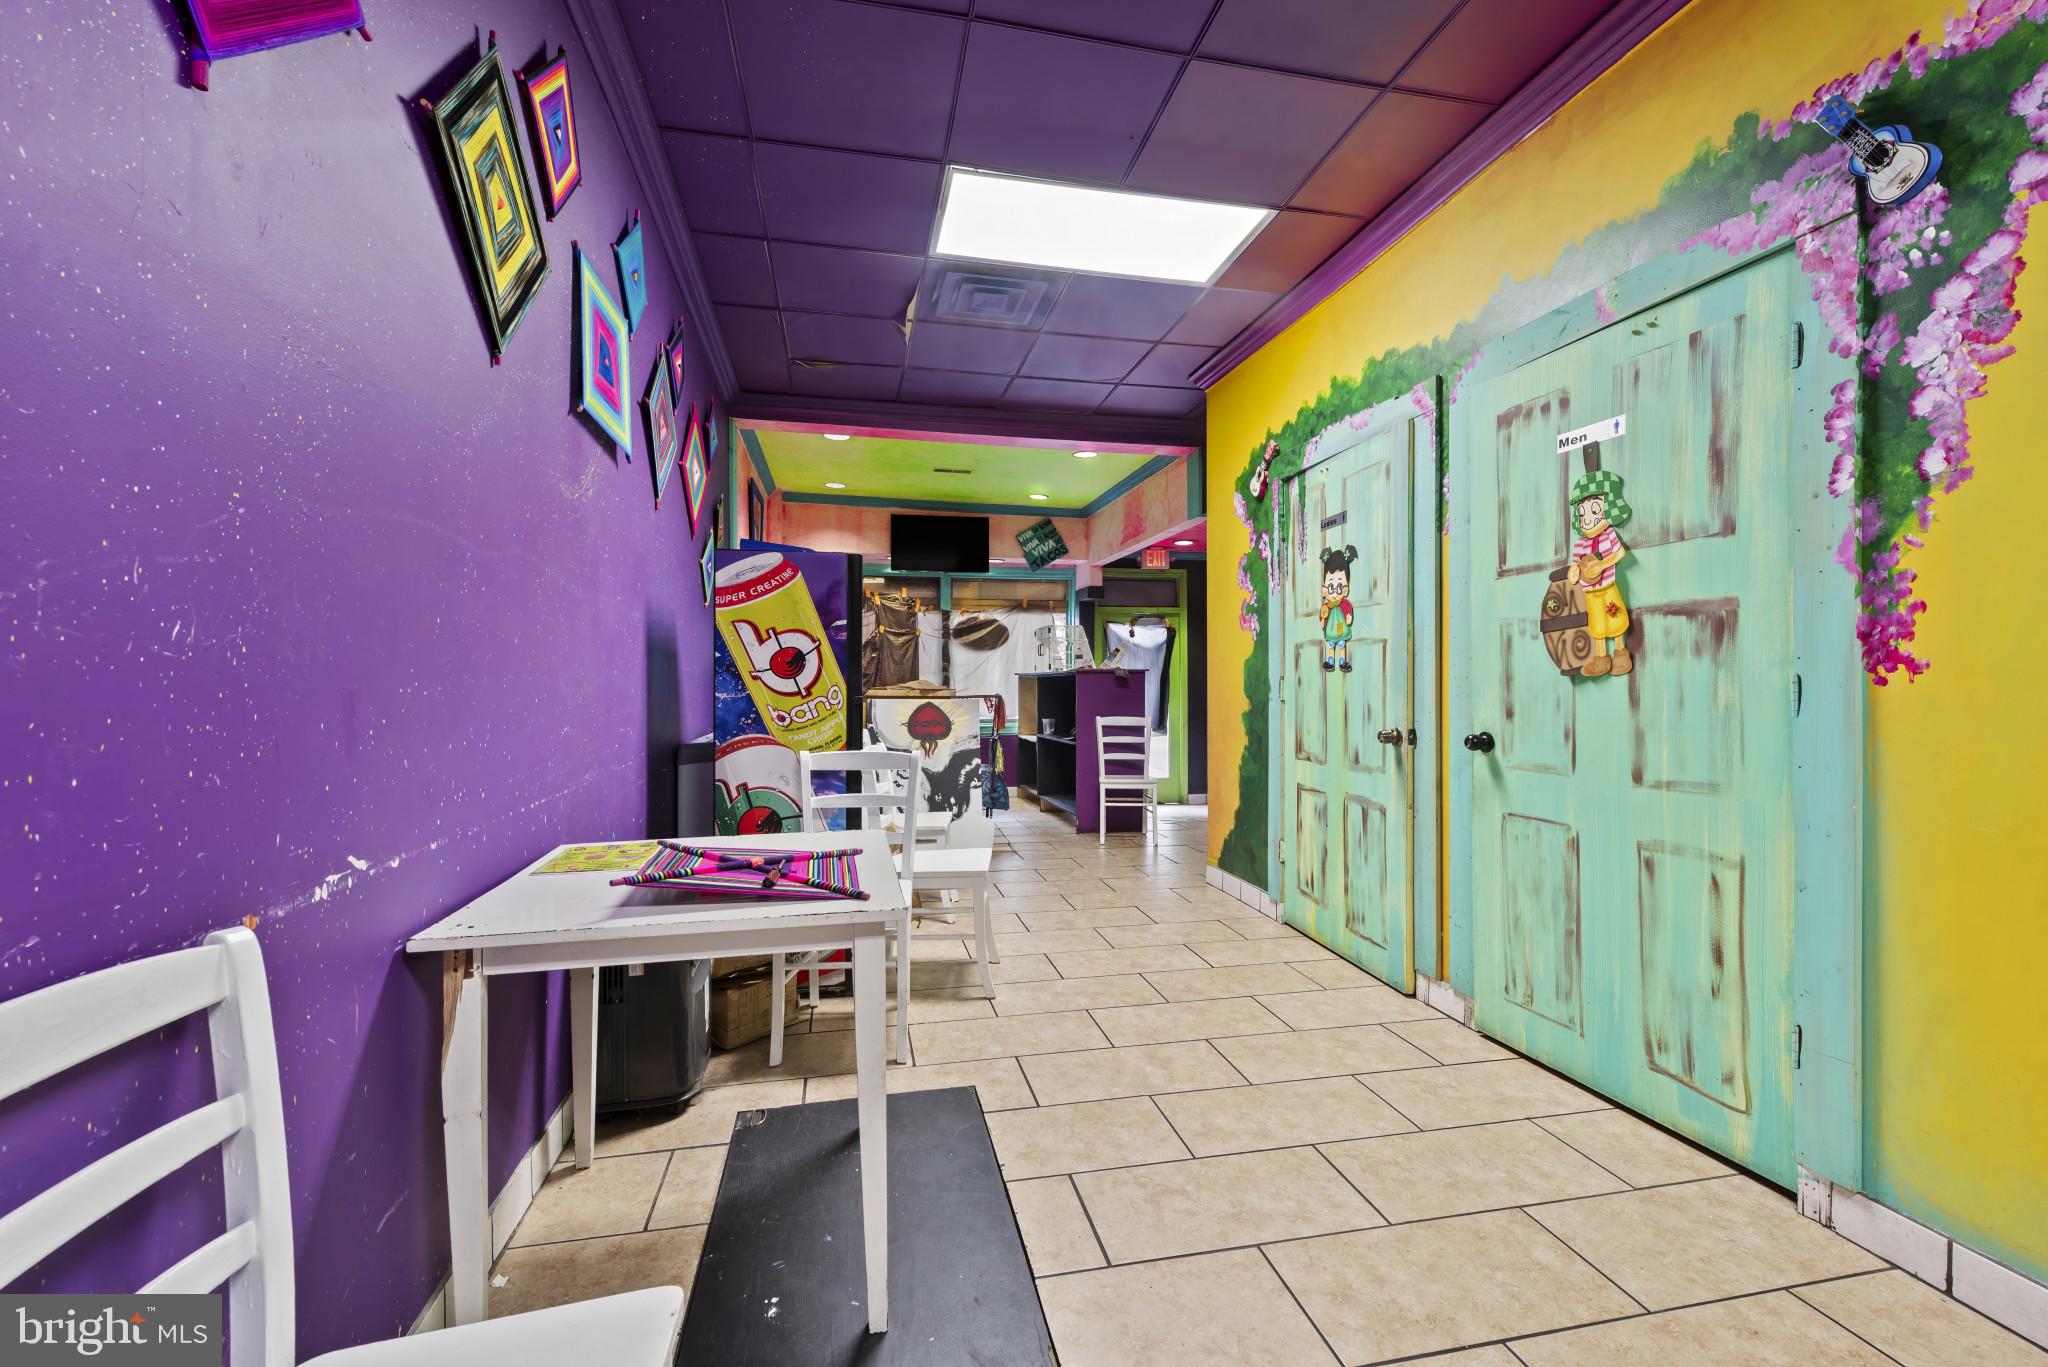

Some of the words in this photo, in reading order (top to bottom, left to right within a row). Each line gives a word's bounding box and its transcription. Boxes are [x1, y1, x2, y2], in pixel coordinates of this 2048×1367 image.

[1559, 434, 1587, 448] Men
[1017, 529, 1034, 543] VIVA
[1022, 538, 1041, 552] VIVA
[1031, 539, 1057, 556] VIVA
[1146, 549, 1166, 567] EXIT
[715, 591, 746, 604] SUPER
[750, 567, 794, 596] CREATINE
[766, 685, 844, 729] bang
